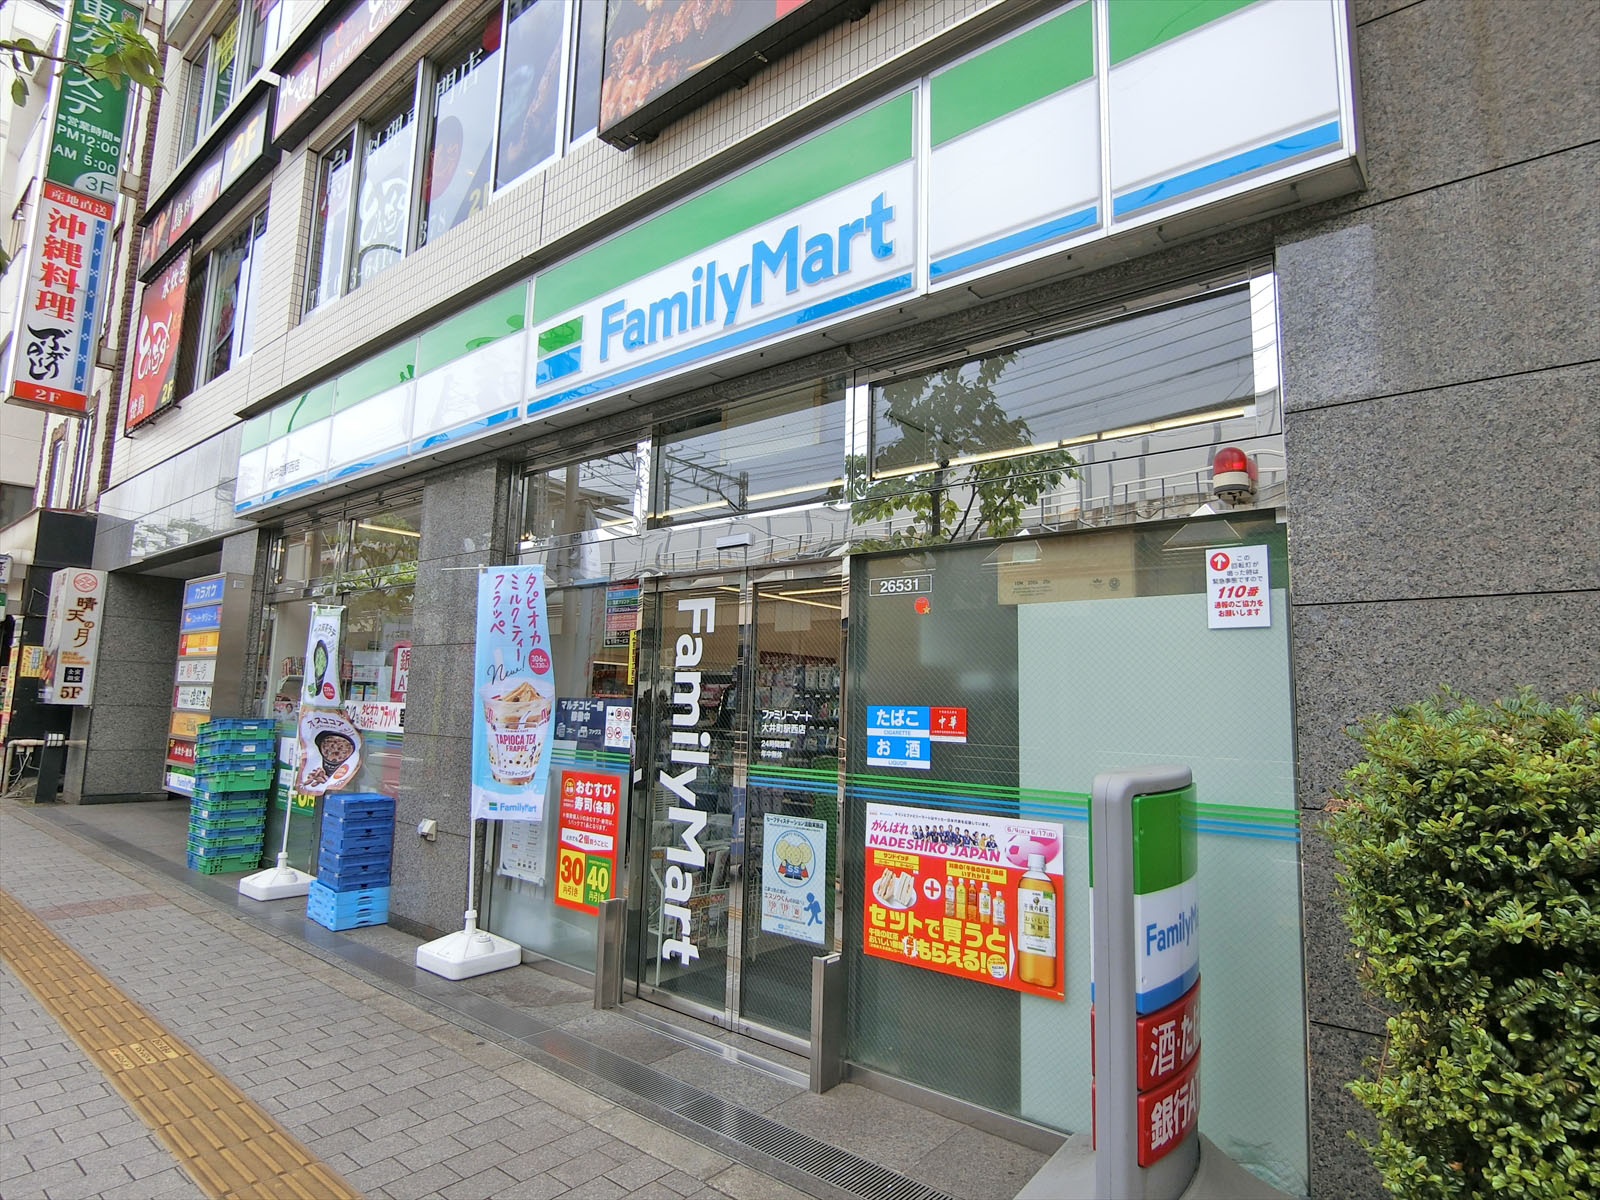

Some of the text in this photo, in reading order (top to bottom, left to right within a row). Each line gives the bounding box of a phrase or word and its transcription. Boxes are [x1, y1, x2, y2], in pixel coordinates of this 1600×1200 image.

[68, 115, 113, 141] 営業時間
[231, 115, 260, 172] 2F
[53, 143, 116, 175] AM 5:00
[86, 176, 115, 194] 3F
[51, 189, 107, 217] 産地直送
[35, 207, 88, 323] 沖縄料理
[600, 191, 894, 363] FamilyMart
[35, 388, 61, 403] 2F
[162, 380, 175, 403] 2F
[880, 578, 919, 593] 26531
[1212, 576, 1263, 584] 緊急事態ですので
[195, 584, 217, 599] カラオケ
[1218, 585, 1260, 599] 110番
[490, 574, 505, 635] フラッペ
[526, 573, 542, 647] タピオカ
[1214, 600, 1264, 609] 通報のご協力を
[1218, 608, 1260, 617] お願いします
[66, 597, 98, 648] 晴天の月
[510, 573, 523, 662] ミルクティー
[60, 686, 83, 699] 5F
[561, 700, 604, 711] マルチコピー機
[762, 710, 812, 721] ファミリーマート
[876, 708, 920, 727] たばこ
[938, 715, 958, 730] 中華
[761, 723, 806, 734] 大井町駅西店
[496, 734, 537, 745] TAPIOCA TEA
[760, 740, 791, 749] 24時間営業
[760, 750, 782, 759] 年中無休
[660, 598, 716, 966] FamilyMart
[500, 802, 537, 814] FamilyMart
[871, 819, 909, 835] がんばれ
[869, 833, 1000, 863] NADESHIKO JAPAN
[560, 855, 584, 886] 30
[788, 865, 799, 874] SS
[587, 865, 609, 893] 40
[563, 885, 579, 897] 円引き
[869, 903, 1006, 954] セットで買うと
[869, 928, 899, 940] 午後の紅茶
[917, 938, 987, 974] もらえる!
